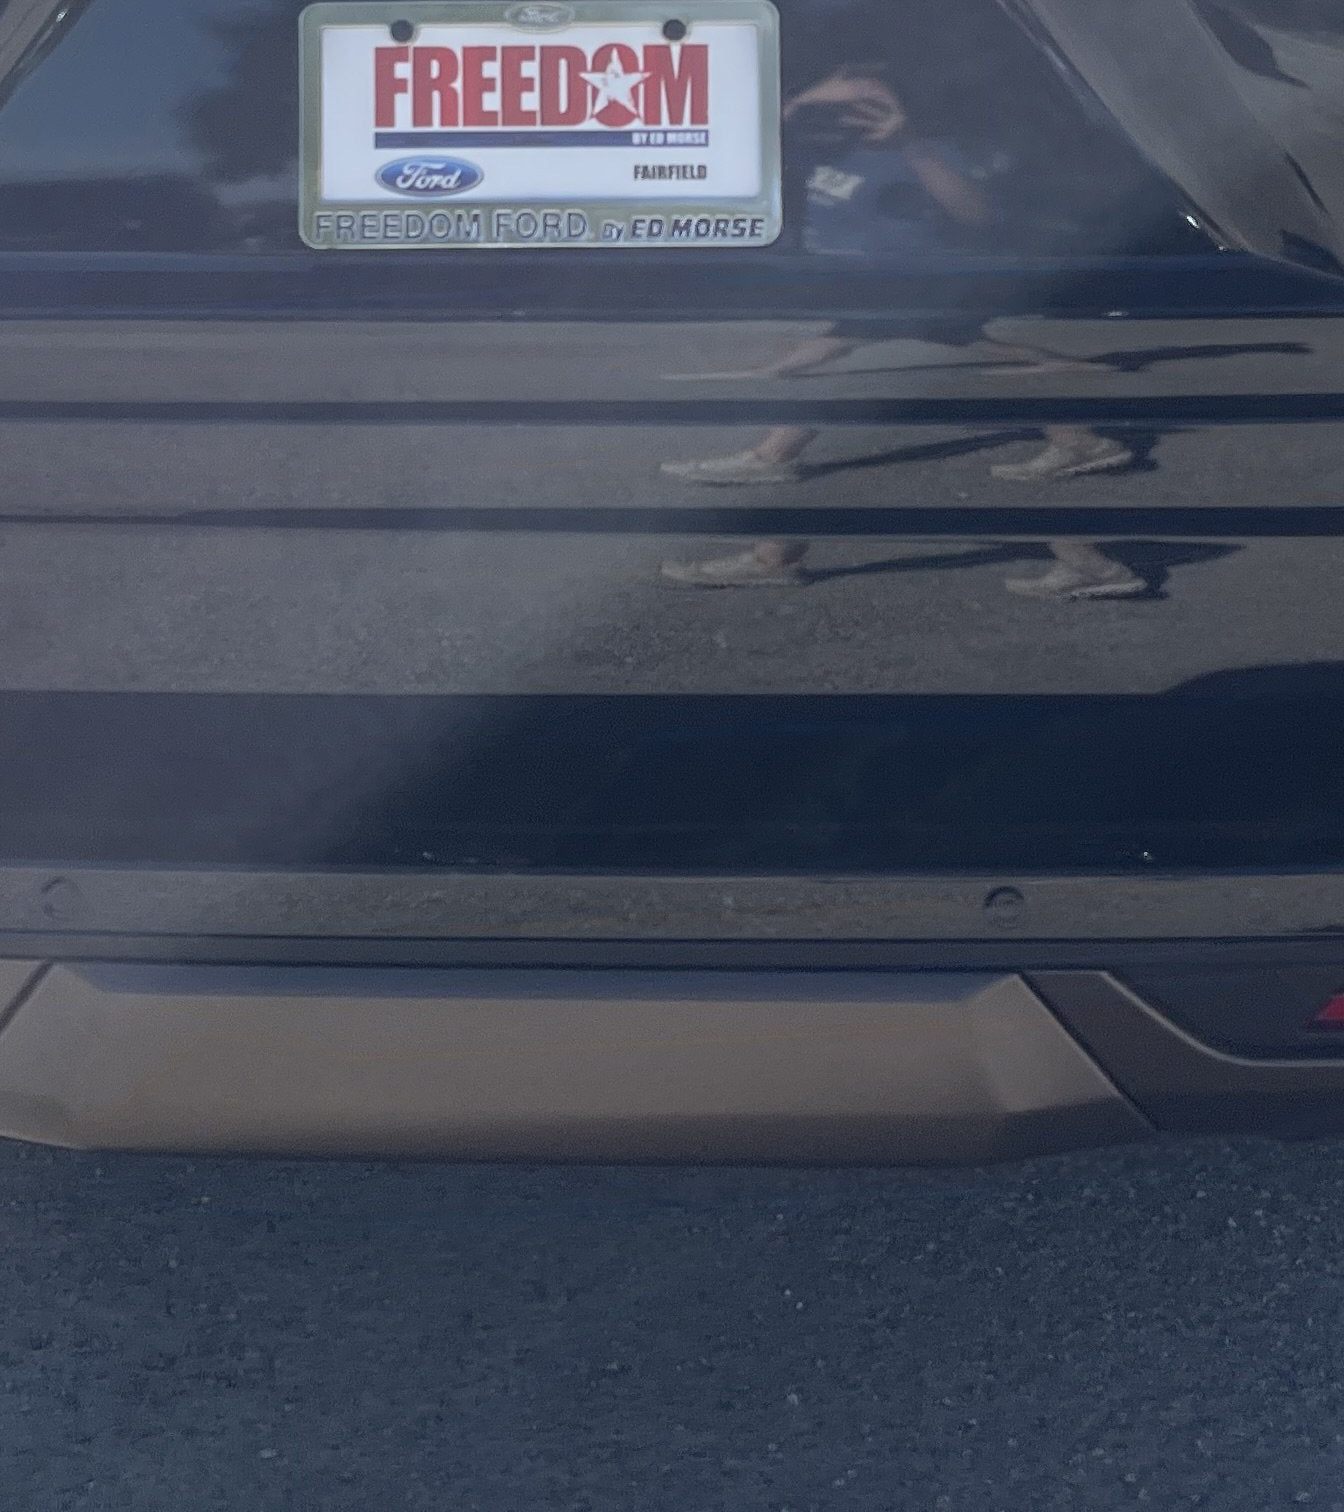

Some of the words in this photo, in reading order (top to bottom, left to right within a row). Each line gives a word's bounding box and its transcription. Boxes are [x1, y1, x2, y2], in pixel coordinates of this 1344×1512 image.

[374, 43, 709, 127] FREEDOM
[666, 131, 707, 146] MORSE
[395, 162, 462, 190] Ford
[633, 164, 708, 181] FAIRFIELD
[314, 211, 481, 240] FREEDOM
[494, 209, 589, 239] FORD
[631, 217, 665, 238] ED
[671, 217, 765, 238] MORSE
